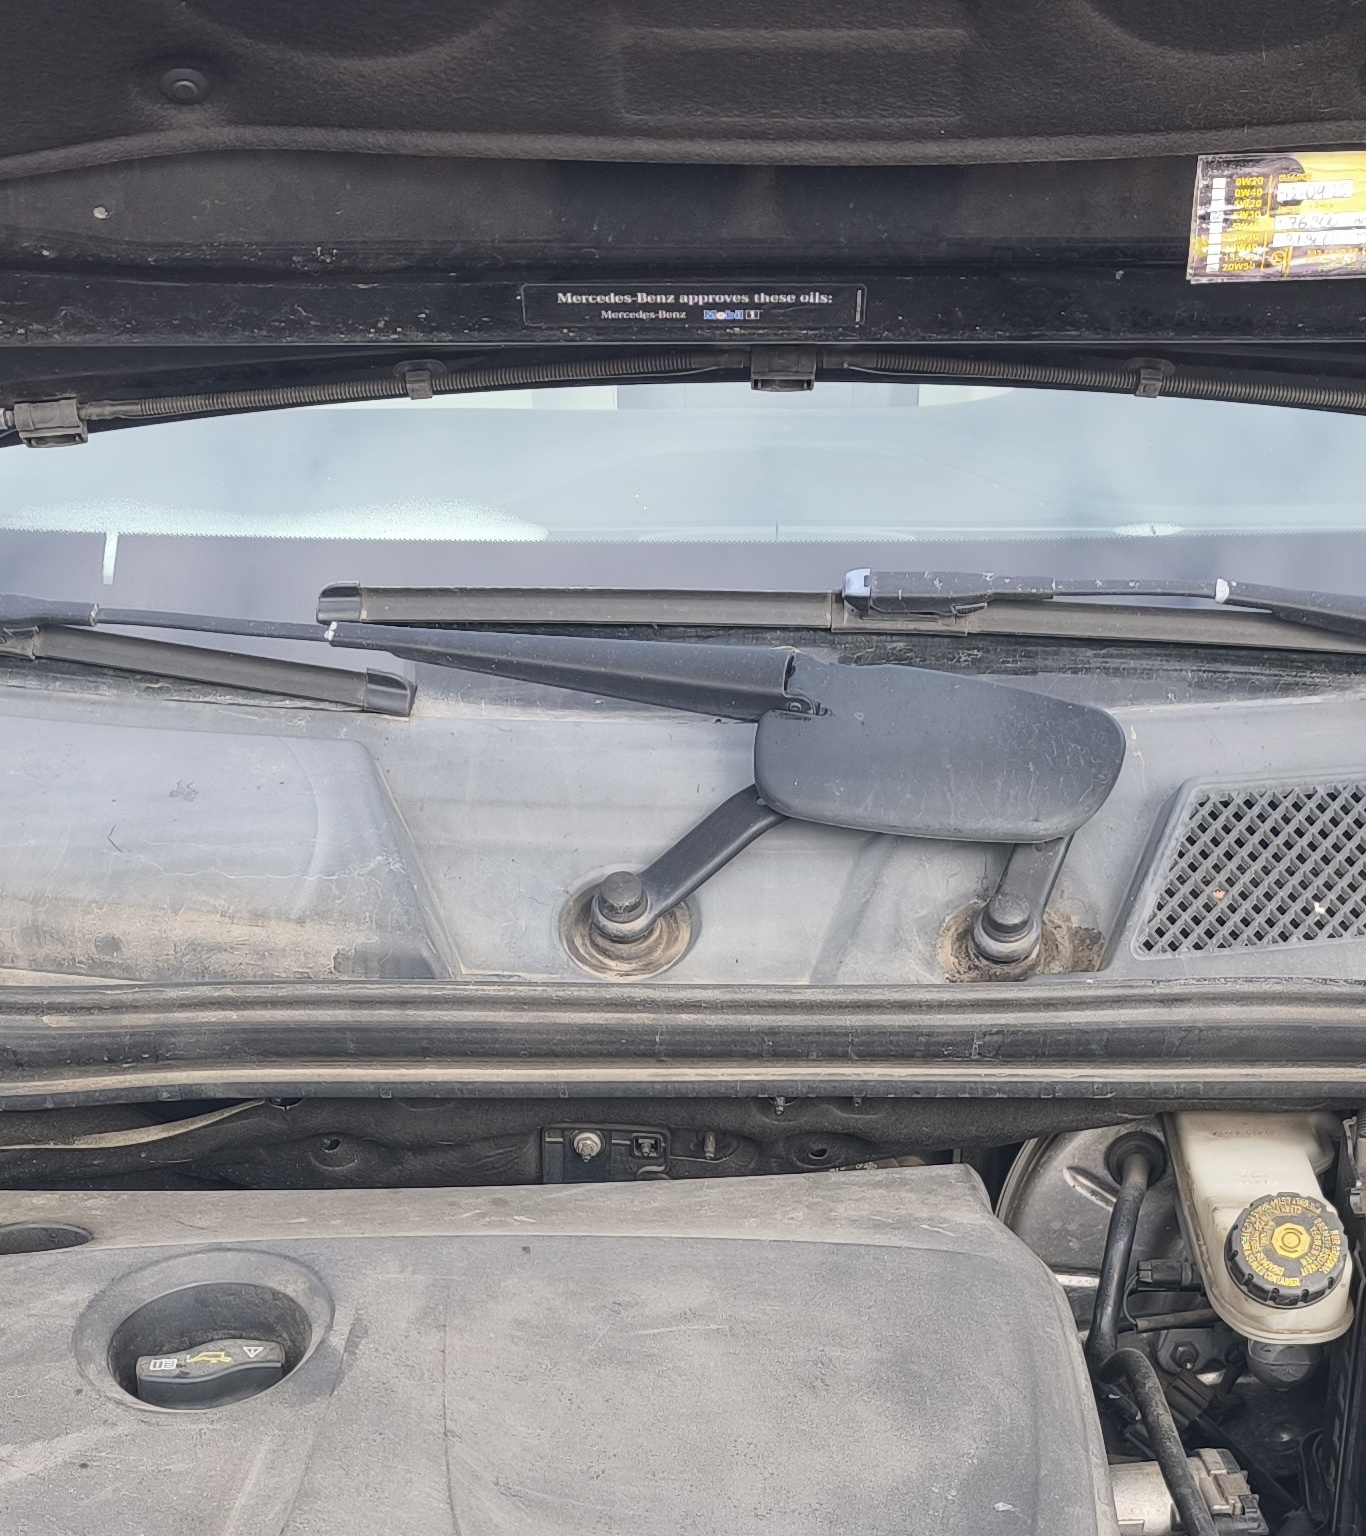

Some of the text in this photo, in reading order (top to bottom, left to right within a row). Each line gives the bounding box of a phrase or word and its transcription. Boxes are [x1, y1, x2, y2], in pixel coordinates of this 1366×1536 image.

[556, 290, 834, 306] Mercedes-Benz approves these oils:
[601, 309, 687, 322] Mercedes-Benz
